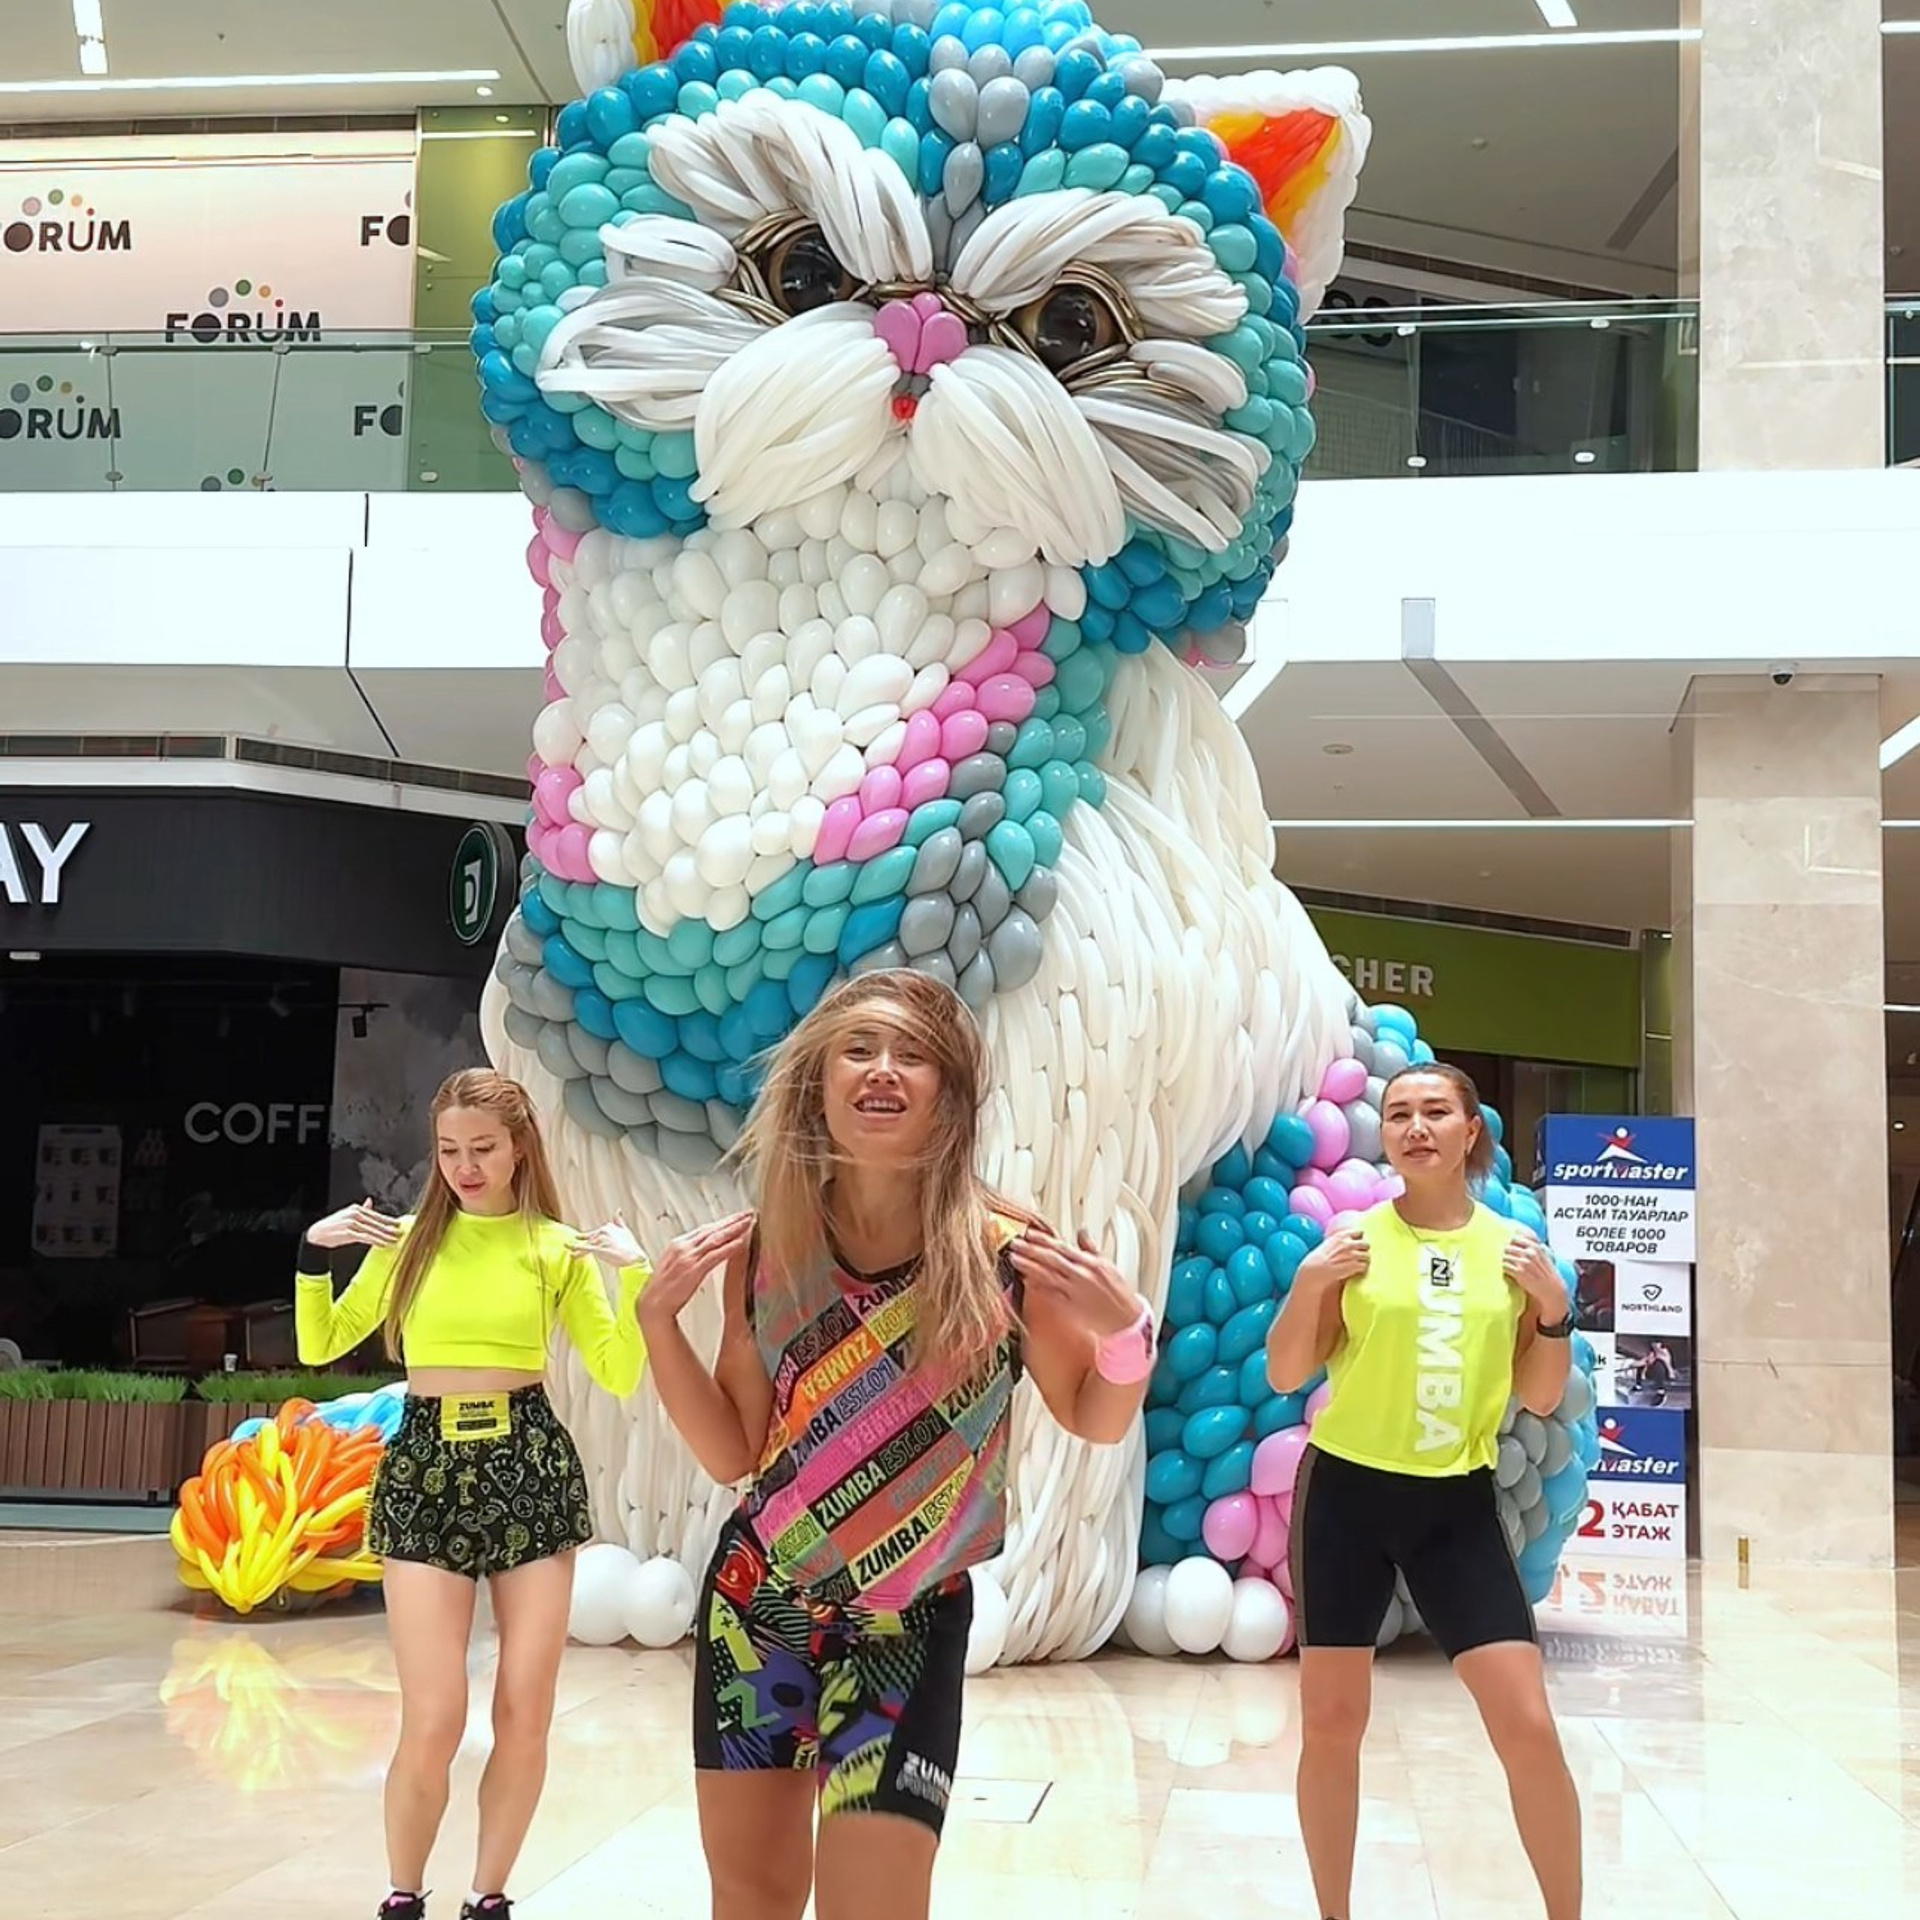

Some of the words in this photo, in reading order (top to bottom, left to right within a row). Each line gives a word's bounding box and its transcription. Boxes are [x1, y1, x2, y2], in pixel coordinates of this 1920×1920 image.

[0, 221, 131, 252] ORUM
[165, 312, 321, 344] FORUM
[1585, 1194, 1658, 1207] 1000-НАН
[1554, 1208, 1606, 1220] АСТАМ
[1611, 1209, 1688, 1222] ТАУАРЛАР
[1576, 1226, 1627, 1239] БОЛЕЕ
[1631, 1229, 1666, 1240] 1000
[1585, 1240, 1658, 1254] ТОВАРОВ
[1621, 1303, 1682, 1314] NORTHLAND
[816, 1460, 887, 1527] ZUMBA
[879, 1409, 942, 1476] EST.01
[1577, 1499, 1605, 1538] 2
[1612, 1502, 1679, 1519] ҚАБАТ
[1612, 1524, 1671, 1541] ЭТАЖ
[856, 1516, 931, 1585] ZUMBA
